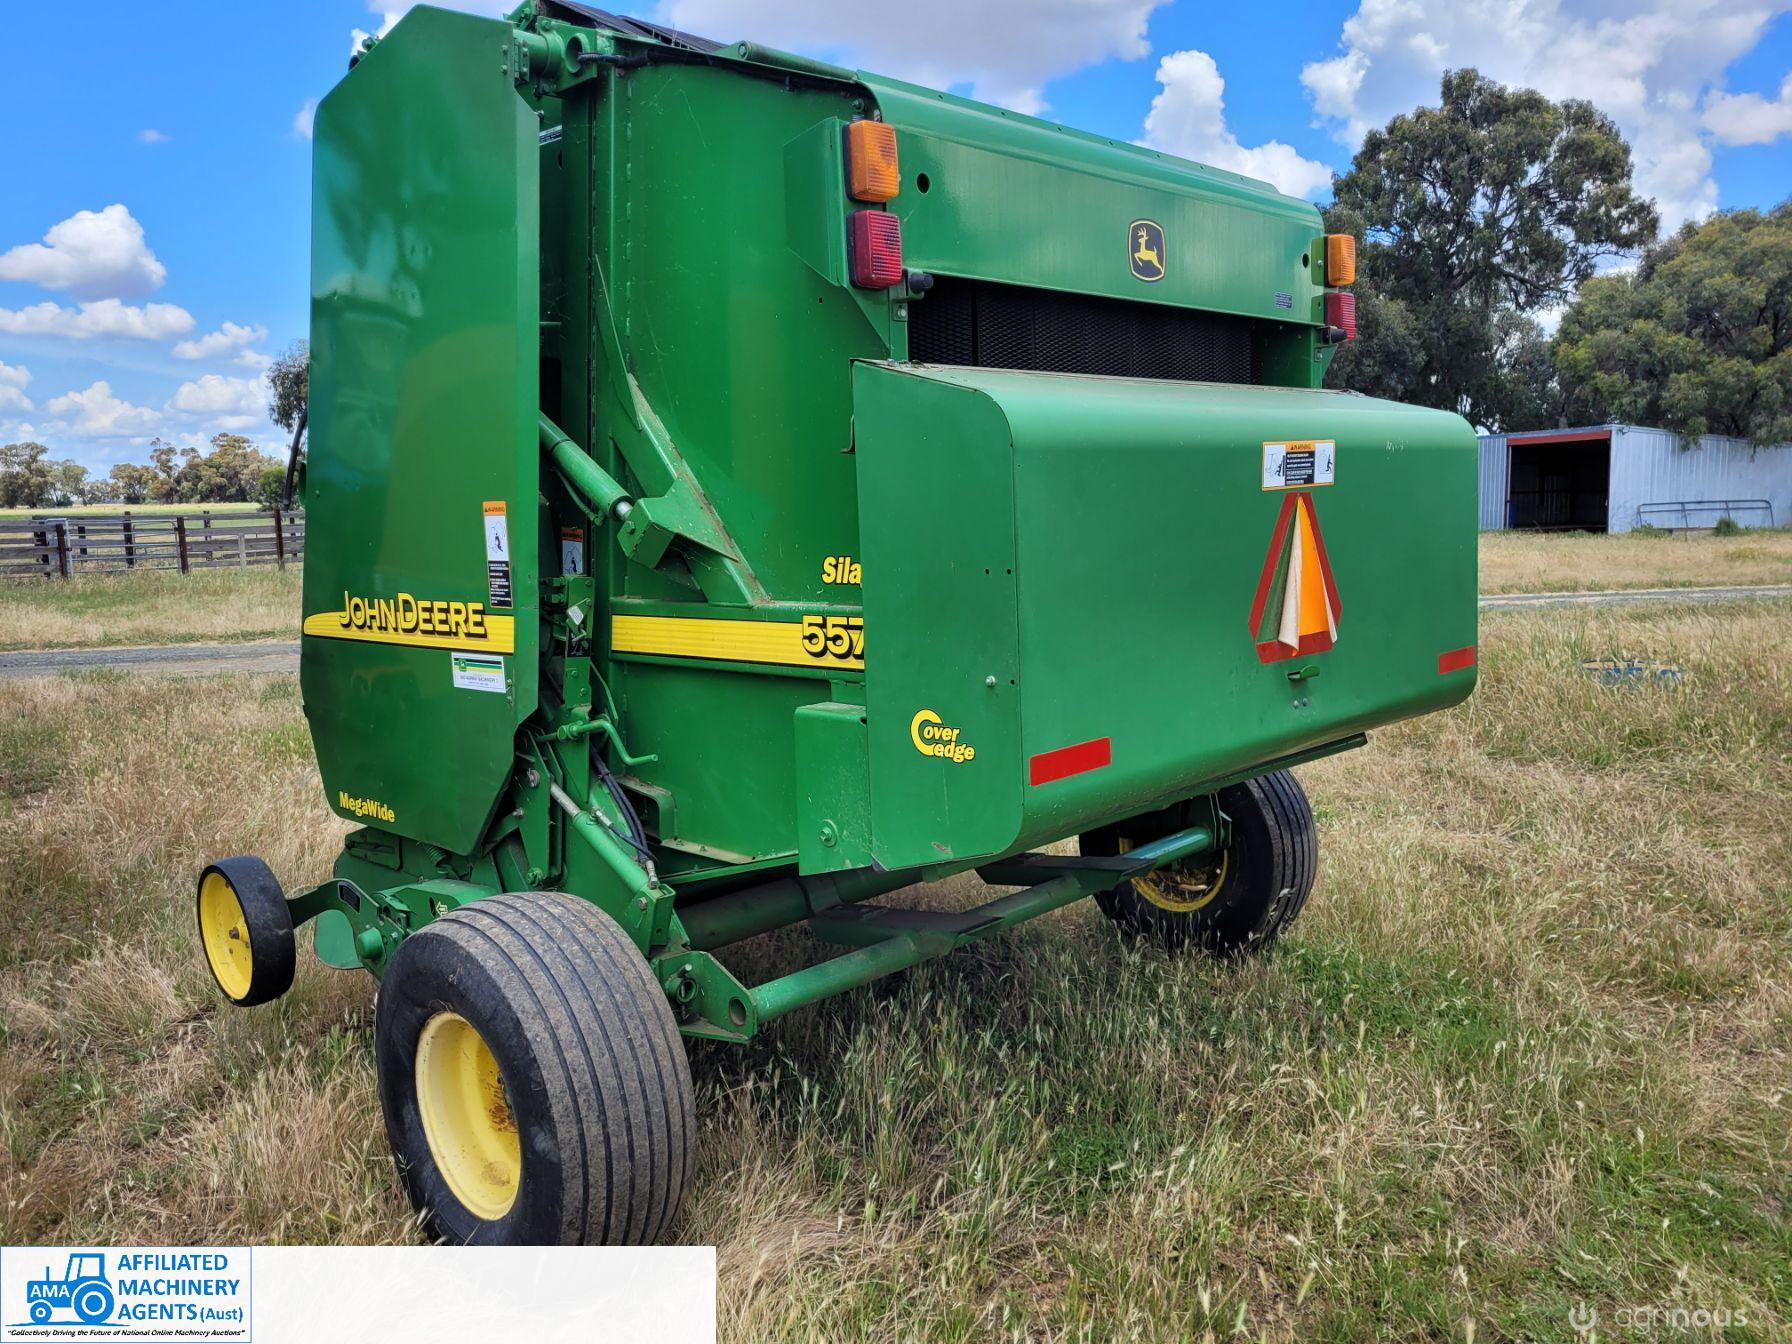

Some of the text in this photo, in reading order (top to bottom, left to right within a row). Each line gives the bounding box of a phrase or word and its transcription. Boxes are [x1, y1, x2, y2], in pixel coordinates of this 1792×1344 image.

[821, 555, 862, 588] Sila
[339, 590, 488, 640] JOHN DEERE
[801, 615, 864, 660] 557
[932, 740, 976, 764] edge
[339, 790, 396, 823] MegaWide
